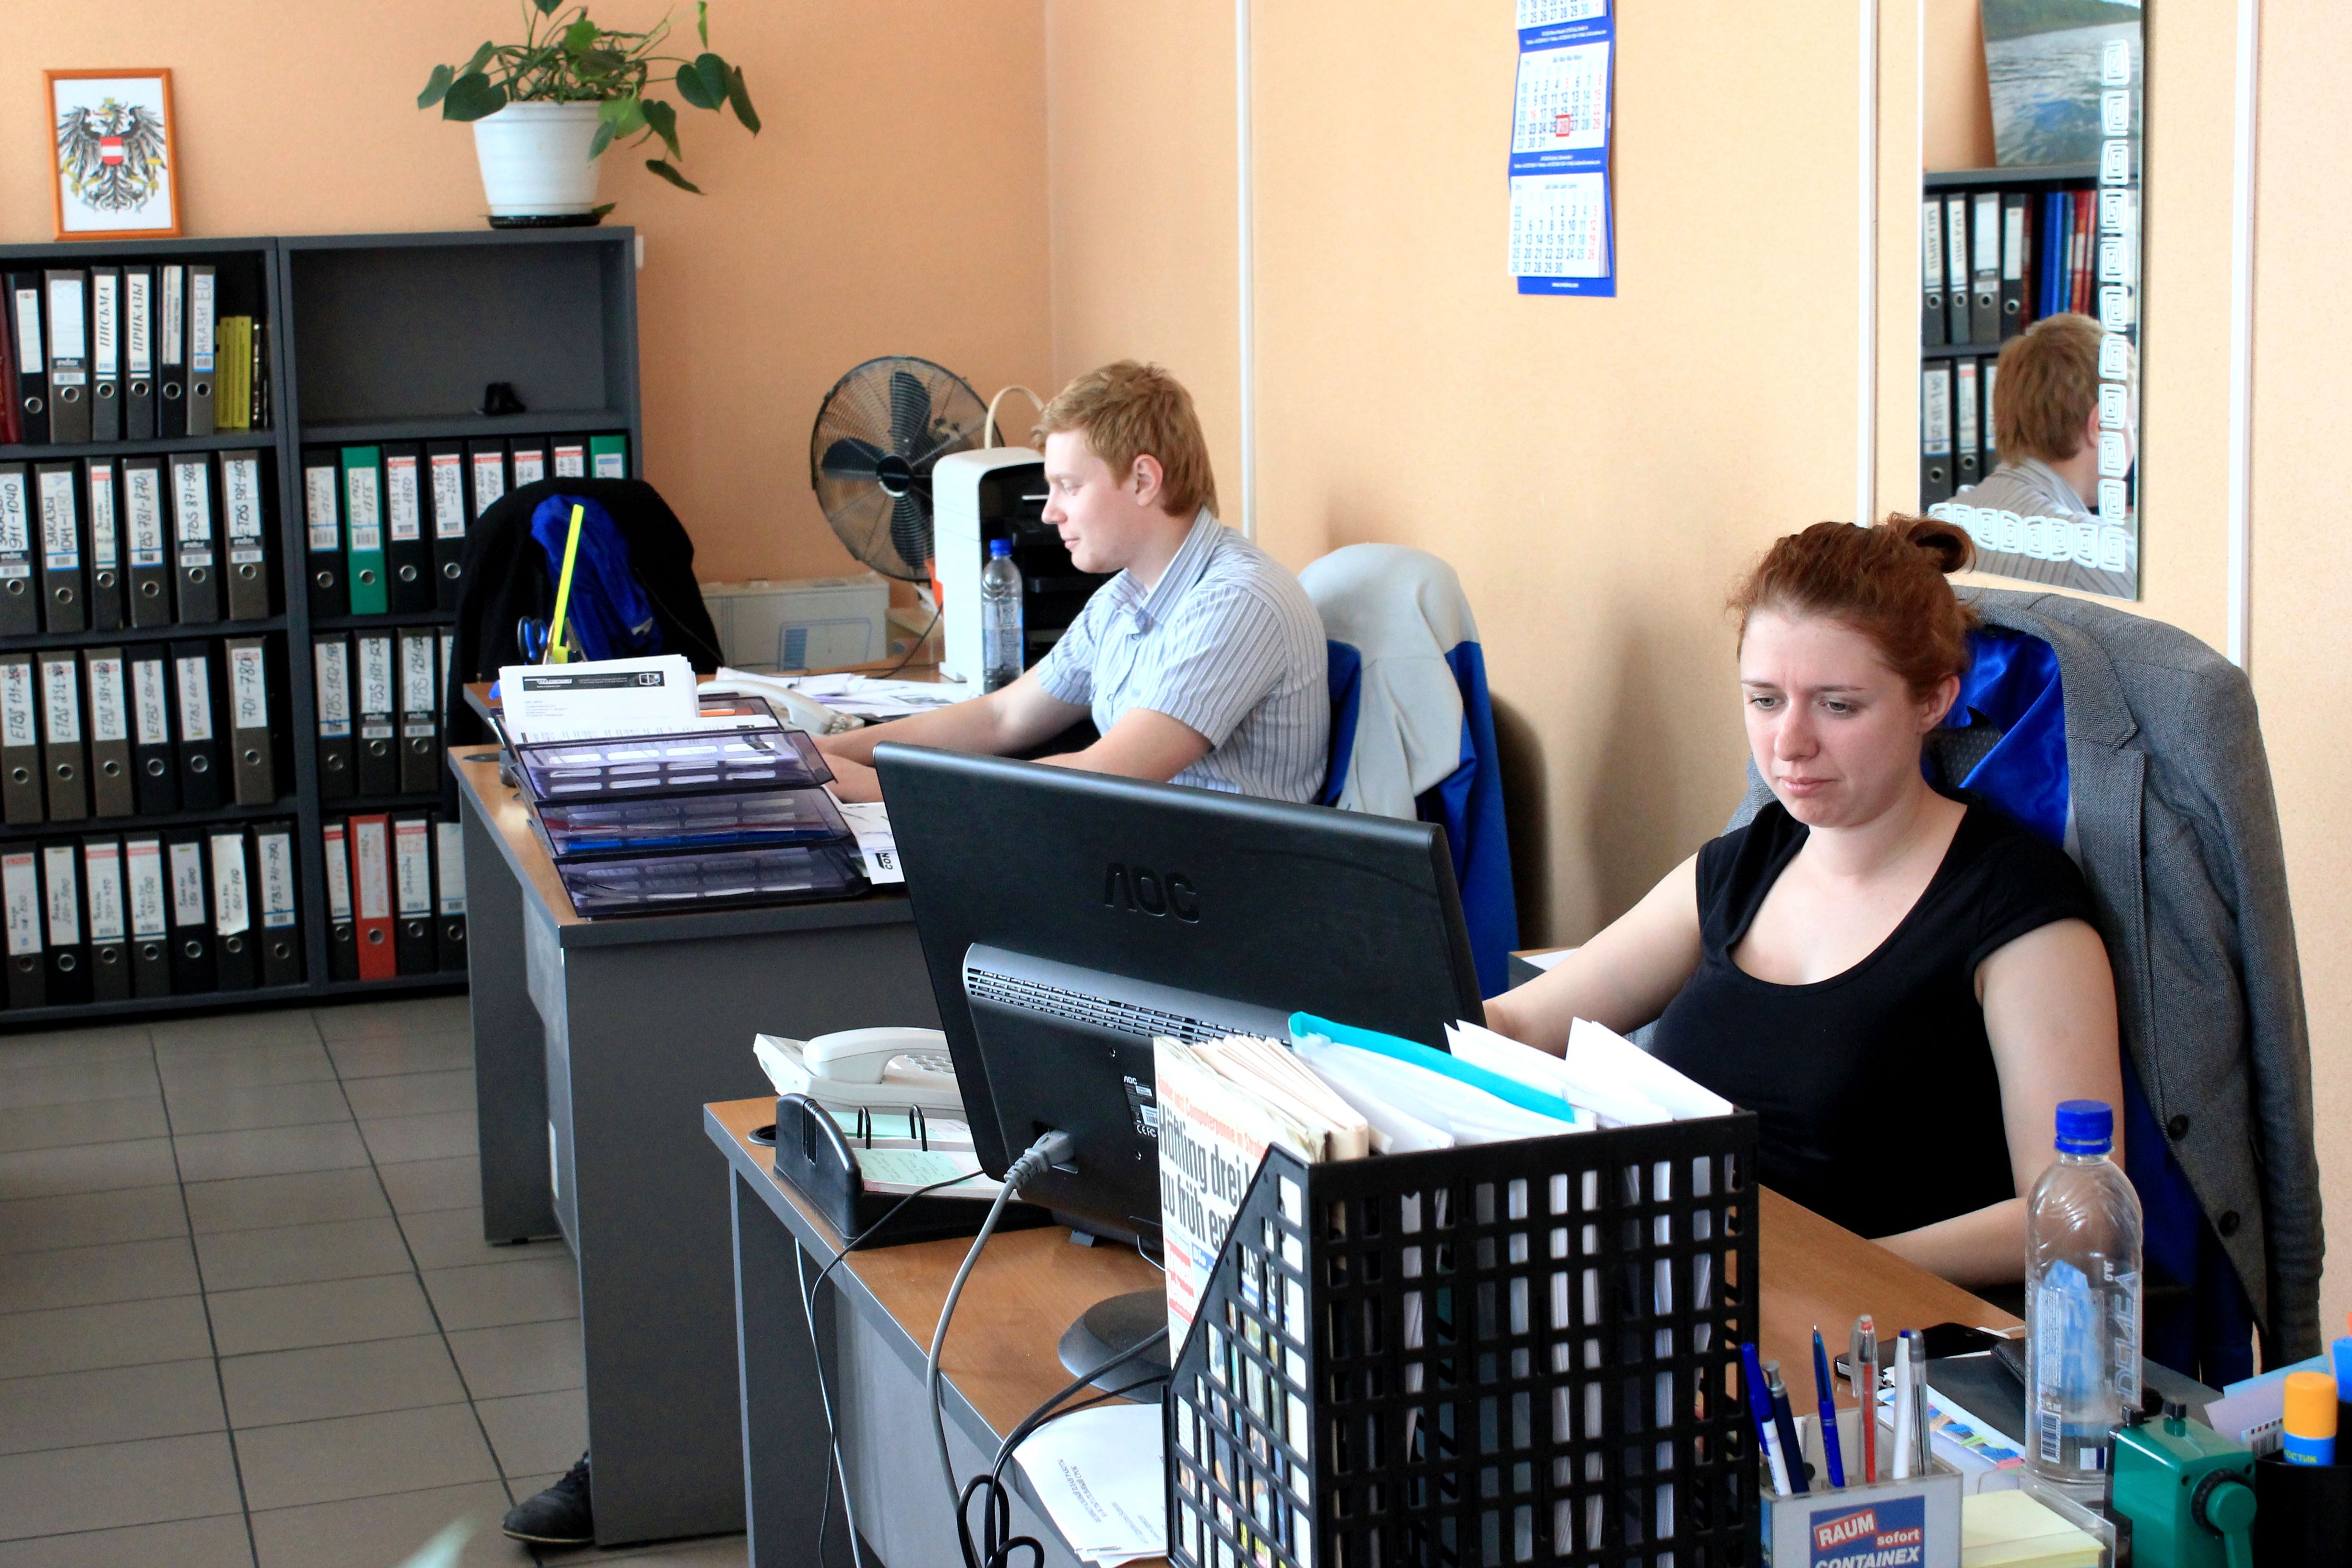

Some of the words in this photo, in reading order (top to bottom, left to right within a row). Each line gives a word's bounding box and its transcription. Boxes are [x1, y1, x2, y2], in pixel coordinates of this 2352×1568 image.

[1531, 12, 1537, 23] 25
[1541, 10, 1547, 22] 26
[1551, 9, 1557, 20] 27
[1560, 7, 1567, 19] 28
[1571, 5, 1577, 17] 29
[1534, 81, 1538, 92] 2
[1545, 80, 1548, 91] 3
[1555, 79, 1559, 88] 4
[1566, 78, 1569, 89] 5
[1576, 76, 1580, 87] 6
[1588, 75, 1591, 86] 7
[1534, 95, 1537, 106] 9
[1541, 94, 1547, 105] 10
[1551, 93, 1557, 104] 11
[1561, 92, 1568, 103] 12
[1572, 91, 1579, 102] 13
[1583, 90, 1590, 101] 14
[1595, 89, 1601, 100] 15
[1541, 108, 1546, 119] 17
[1551, 107, 1556, 118] 18
[1561, 106, 1568, 115] 19
[1571, 106, 1578, 117] 20
[1583, 104, 1589, 116] 21
[1529, 123, 1536, 134] 23
[1539, 122, 1546, 134] 24
[1549, 121, 1556, 133] 25
[1570, 119, 1578, 131] 27
[1528, 137, 1535, 148] 30
[1539, 137, 1545, 148] 31
[1561, 205, 1564, 216] 2
[1572, 205, 1576, 216] 3
[1583, 205, 1587, 215] 4
[1594, 205, 1597, 216] 5
[1529, 220, 1532, 231] 6
[1540, 220, 1543, 230] 7
[1550, 220, 1553, 230] 8
[1561, 220, 1564, 230] 9
[1568, 220, 1576, 231] 10
[1526, 234, 1532, 245] 13
[1536, 234, 1543, 245] 14
[1547, 234, 1553, 245] 15
[1557, 234, 1564, 245] 16
[1568, 234, 1575, 245] 17
[1524, 248, 1532, 259] 20
[1535, 248, 1542, 259] 21
[1545, 248, 1552, 259] 22
[1556, 248, 1563, 259] 23
[1567, 249, 1574, 260] 24
[1524, 262, 1531, 272] 27
[1534, 262, 1541, 273] 28
[1544, 262, 1552, 273] 29
[1555, 262, 1562, 273] 30
[99, 286, 110, 347] ПИСЬМА
[132, 283, 143, 352] ПРИКАЗЫ
[1104, 862, 1200, 924] AOC
[1124, 1075, 1138, 1085] AOC
[1158, 1101, 1208, 1194] Häftling
[1211, 1144, 1243, 1207] drei
[1161, 1169, 1175, 1217] zu
[1177, 1174, 1206, 1243] früh
[1818, 1513, 1875, 1548] RAUM
[1877, 1528, 1920, 1546] sofort
